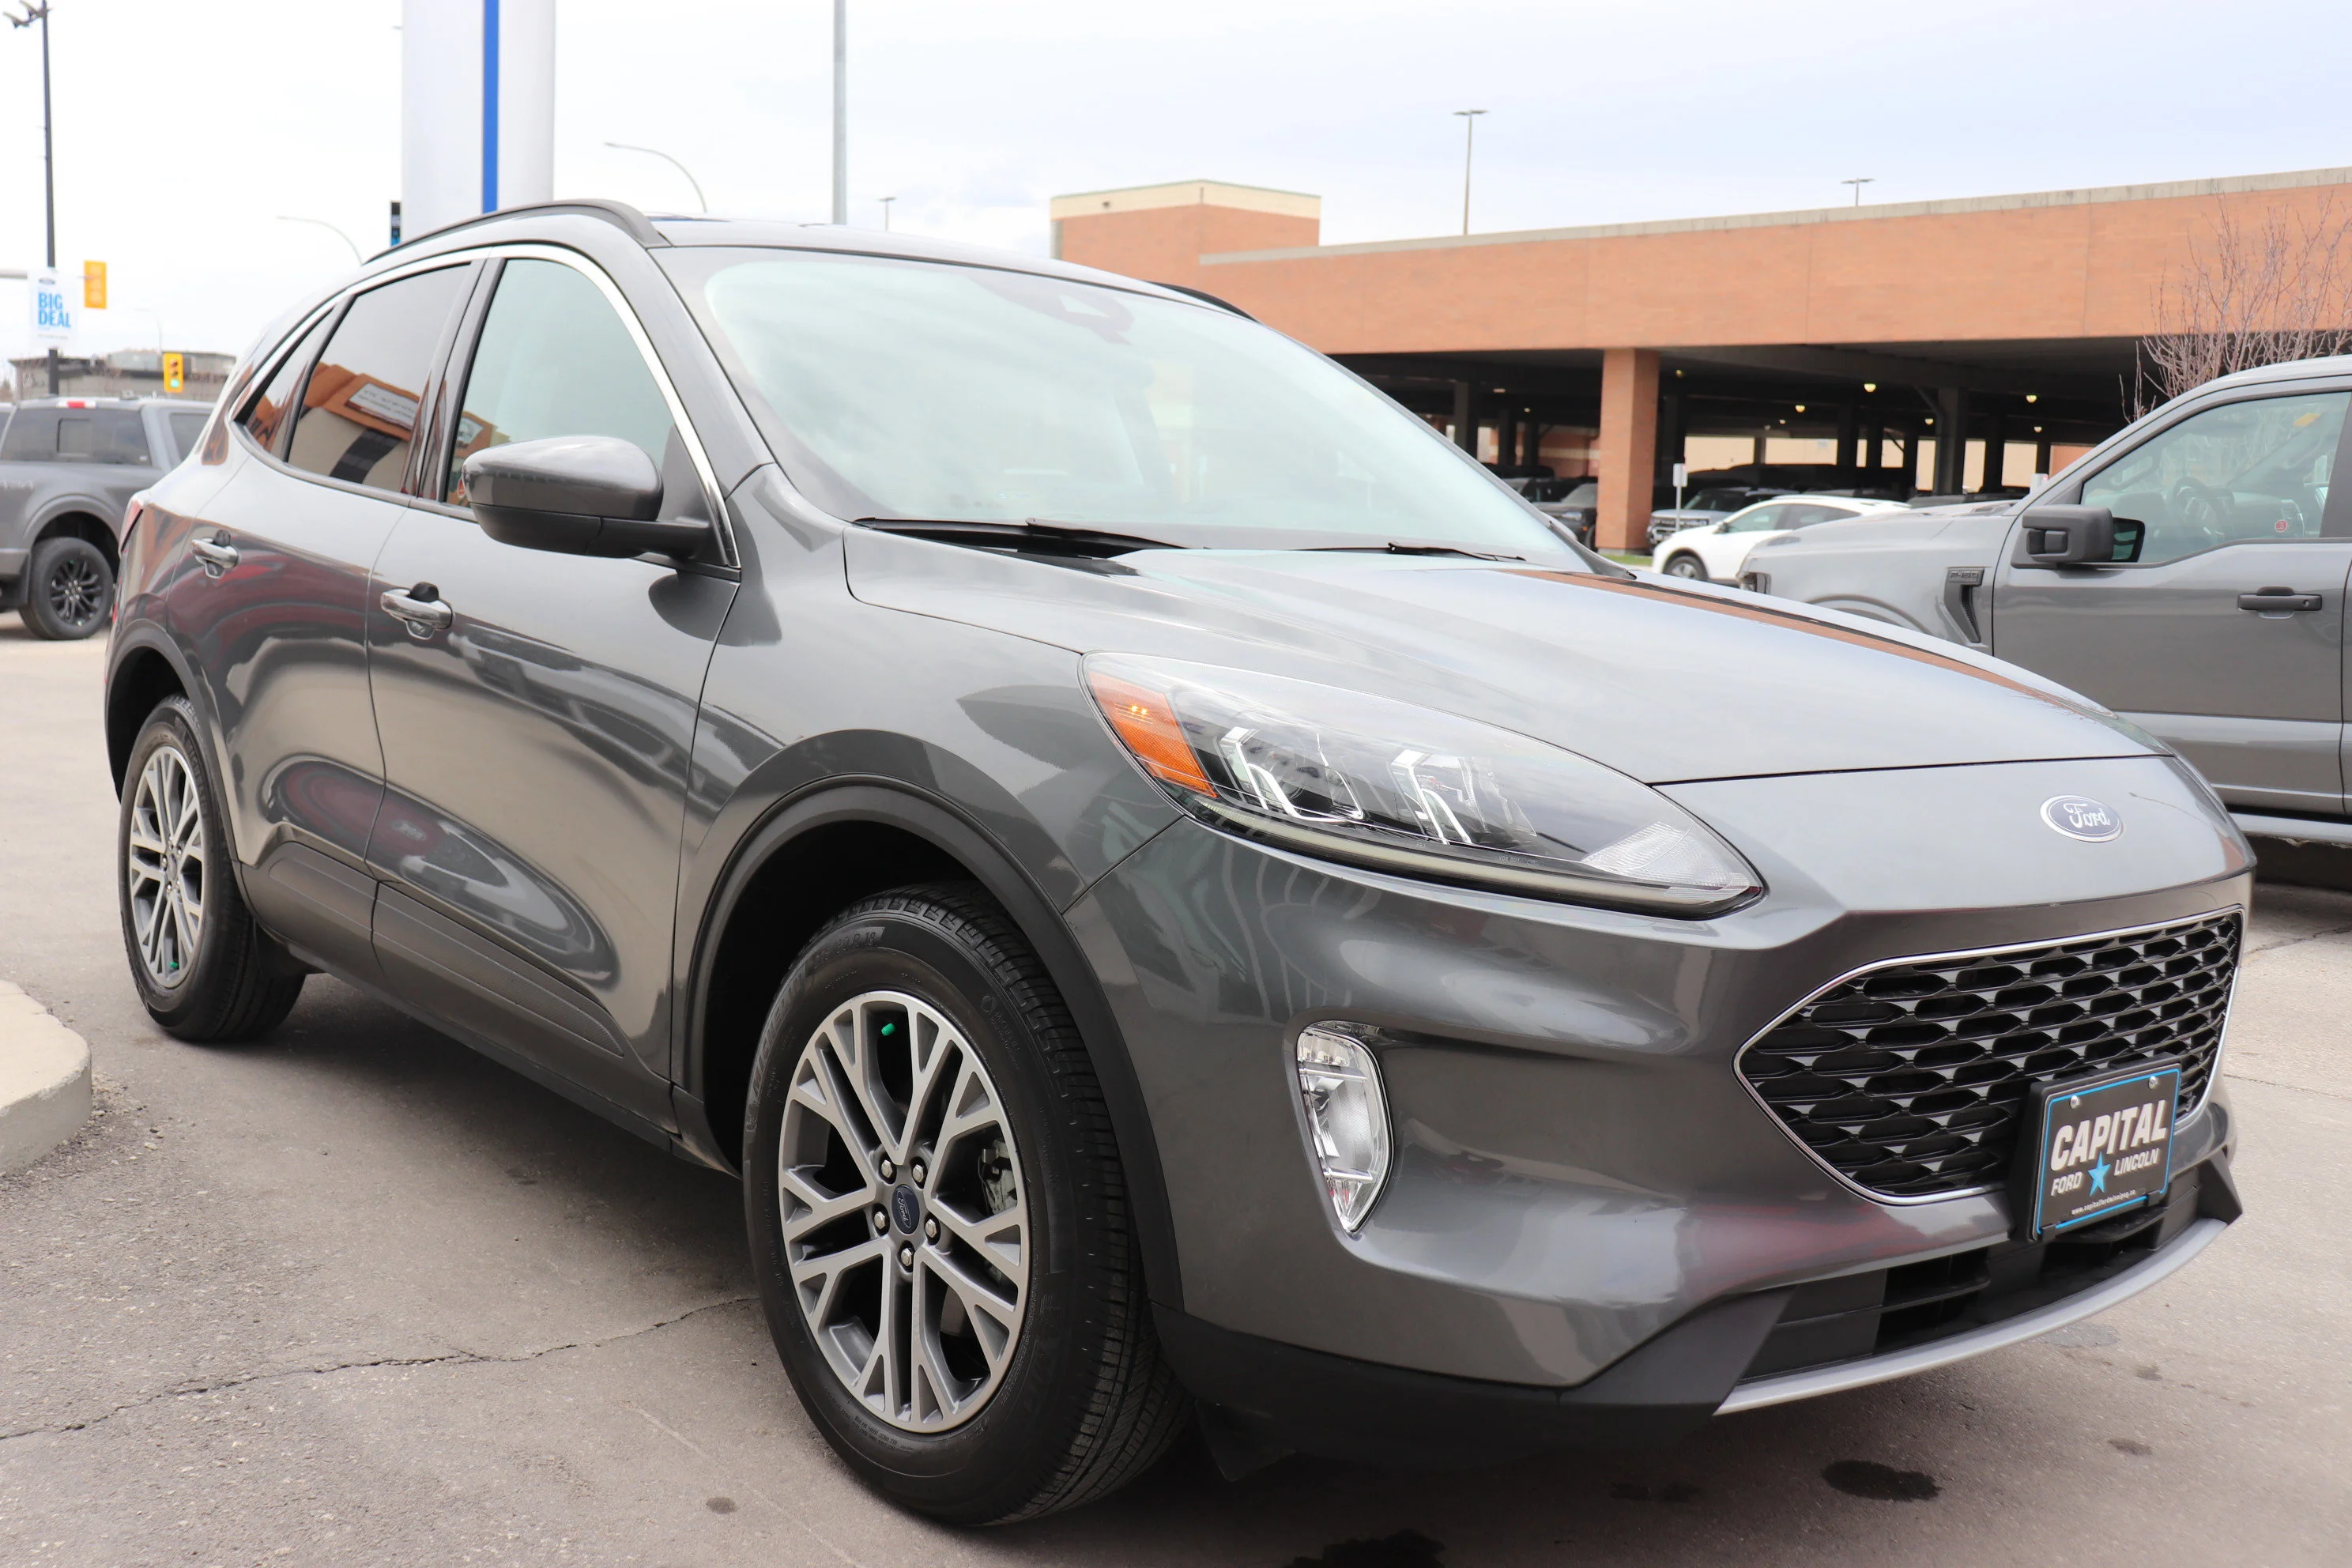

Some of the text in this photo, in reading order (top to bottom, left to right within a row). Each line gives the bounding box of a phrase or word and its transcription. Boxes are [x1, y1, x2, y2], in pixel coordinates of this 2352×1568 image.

[38, 292, 63, 309] BIG
[38, 309, 71, 328] DEAL
[2063, 803, 2110, 828] Ford
[2051, 1099, 2168, 1171] CAPITAL
[2051, 1148, 2159, 1197] FORD LINCOLN
[897, 1197, 909, 1223] Ford
